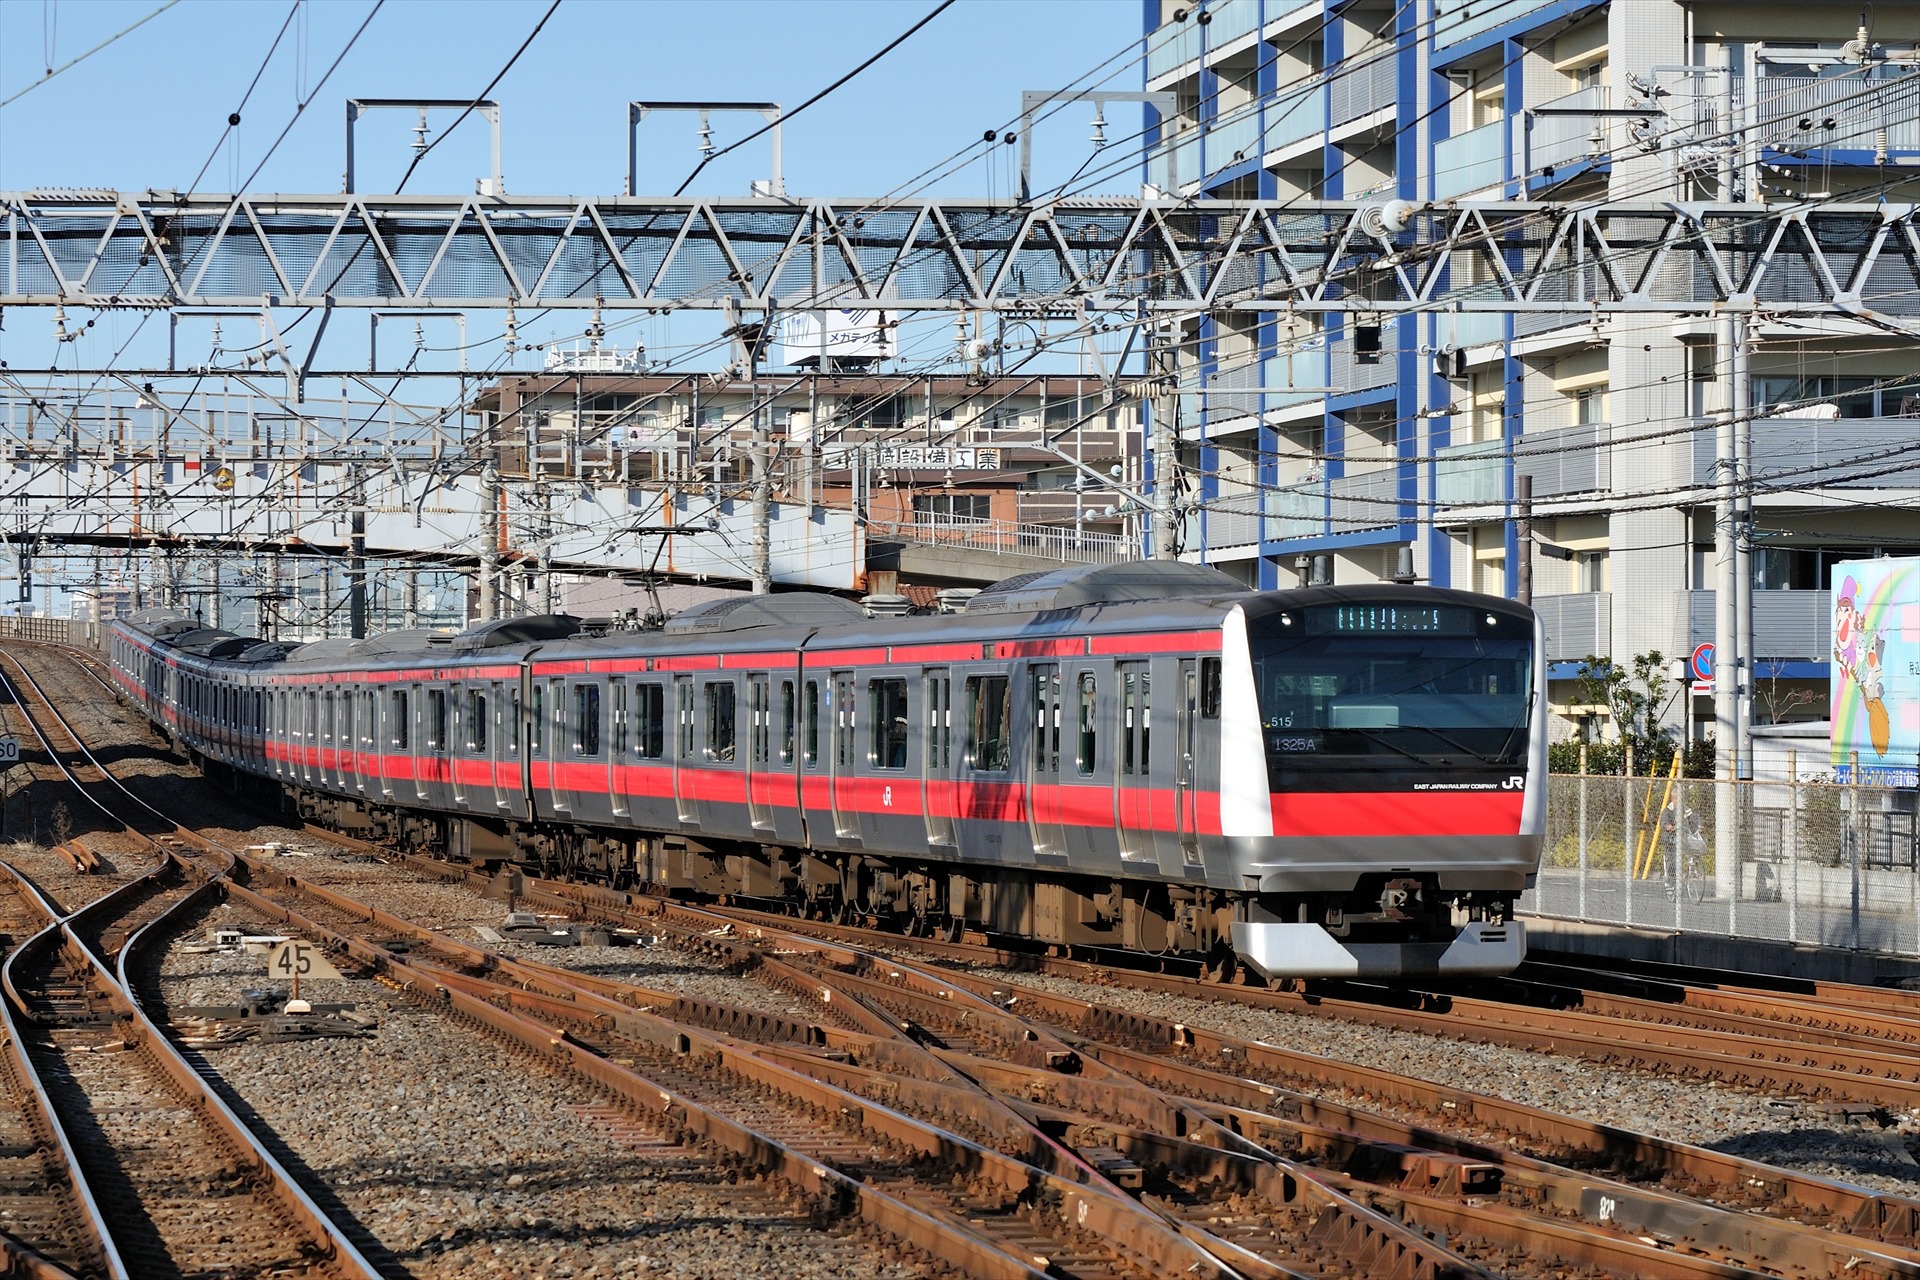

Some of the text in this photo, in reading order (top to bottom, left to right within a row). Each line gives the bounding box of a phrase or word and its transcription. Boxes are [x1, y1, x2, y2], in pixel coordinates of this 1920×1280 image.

[1271, 716, 1292, 727] 515
[1275, 738, 1316, 751] 1325A
[1501, 776, 1524, 790] JR
[882, 785, 893, 807] JR
[278, 946, 311, 974] 45
